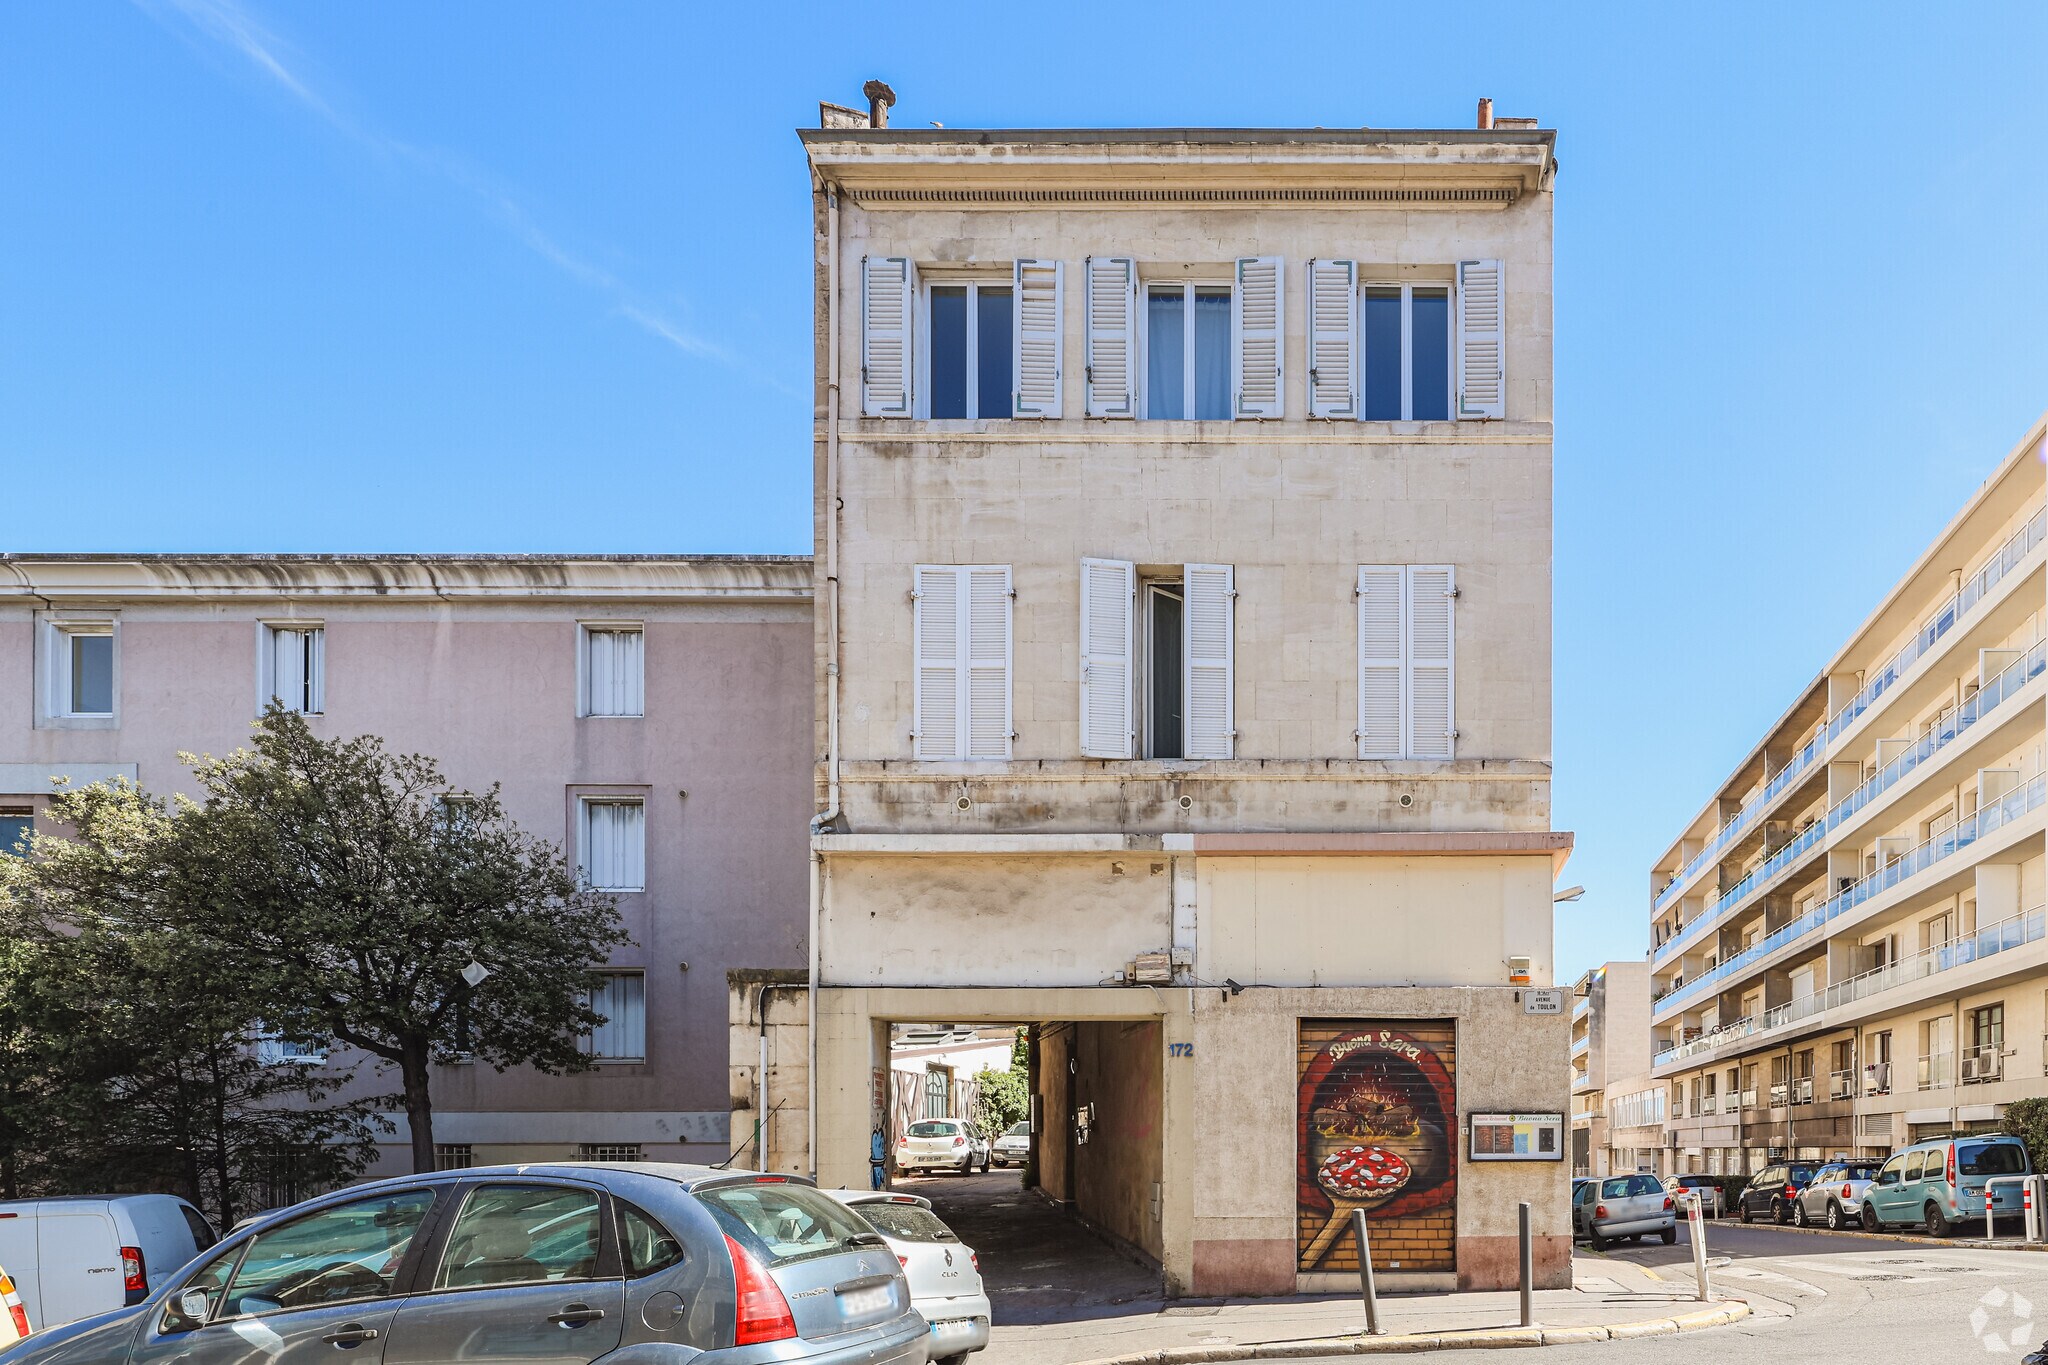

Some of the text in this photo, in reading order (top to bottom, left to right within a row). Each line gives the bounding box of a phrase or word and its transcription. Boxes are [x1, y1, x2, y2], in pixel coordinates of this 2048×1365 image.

[1169, 1043, 1194, 1057] 172
[1329, 1029, 1421, 1060] Buona Sera
